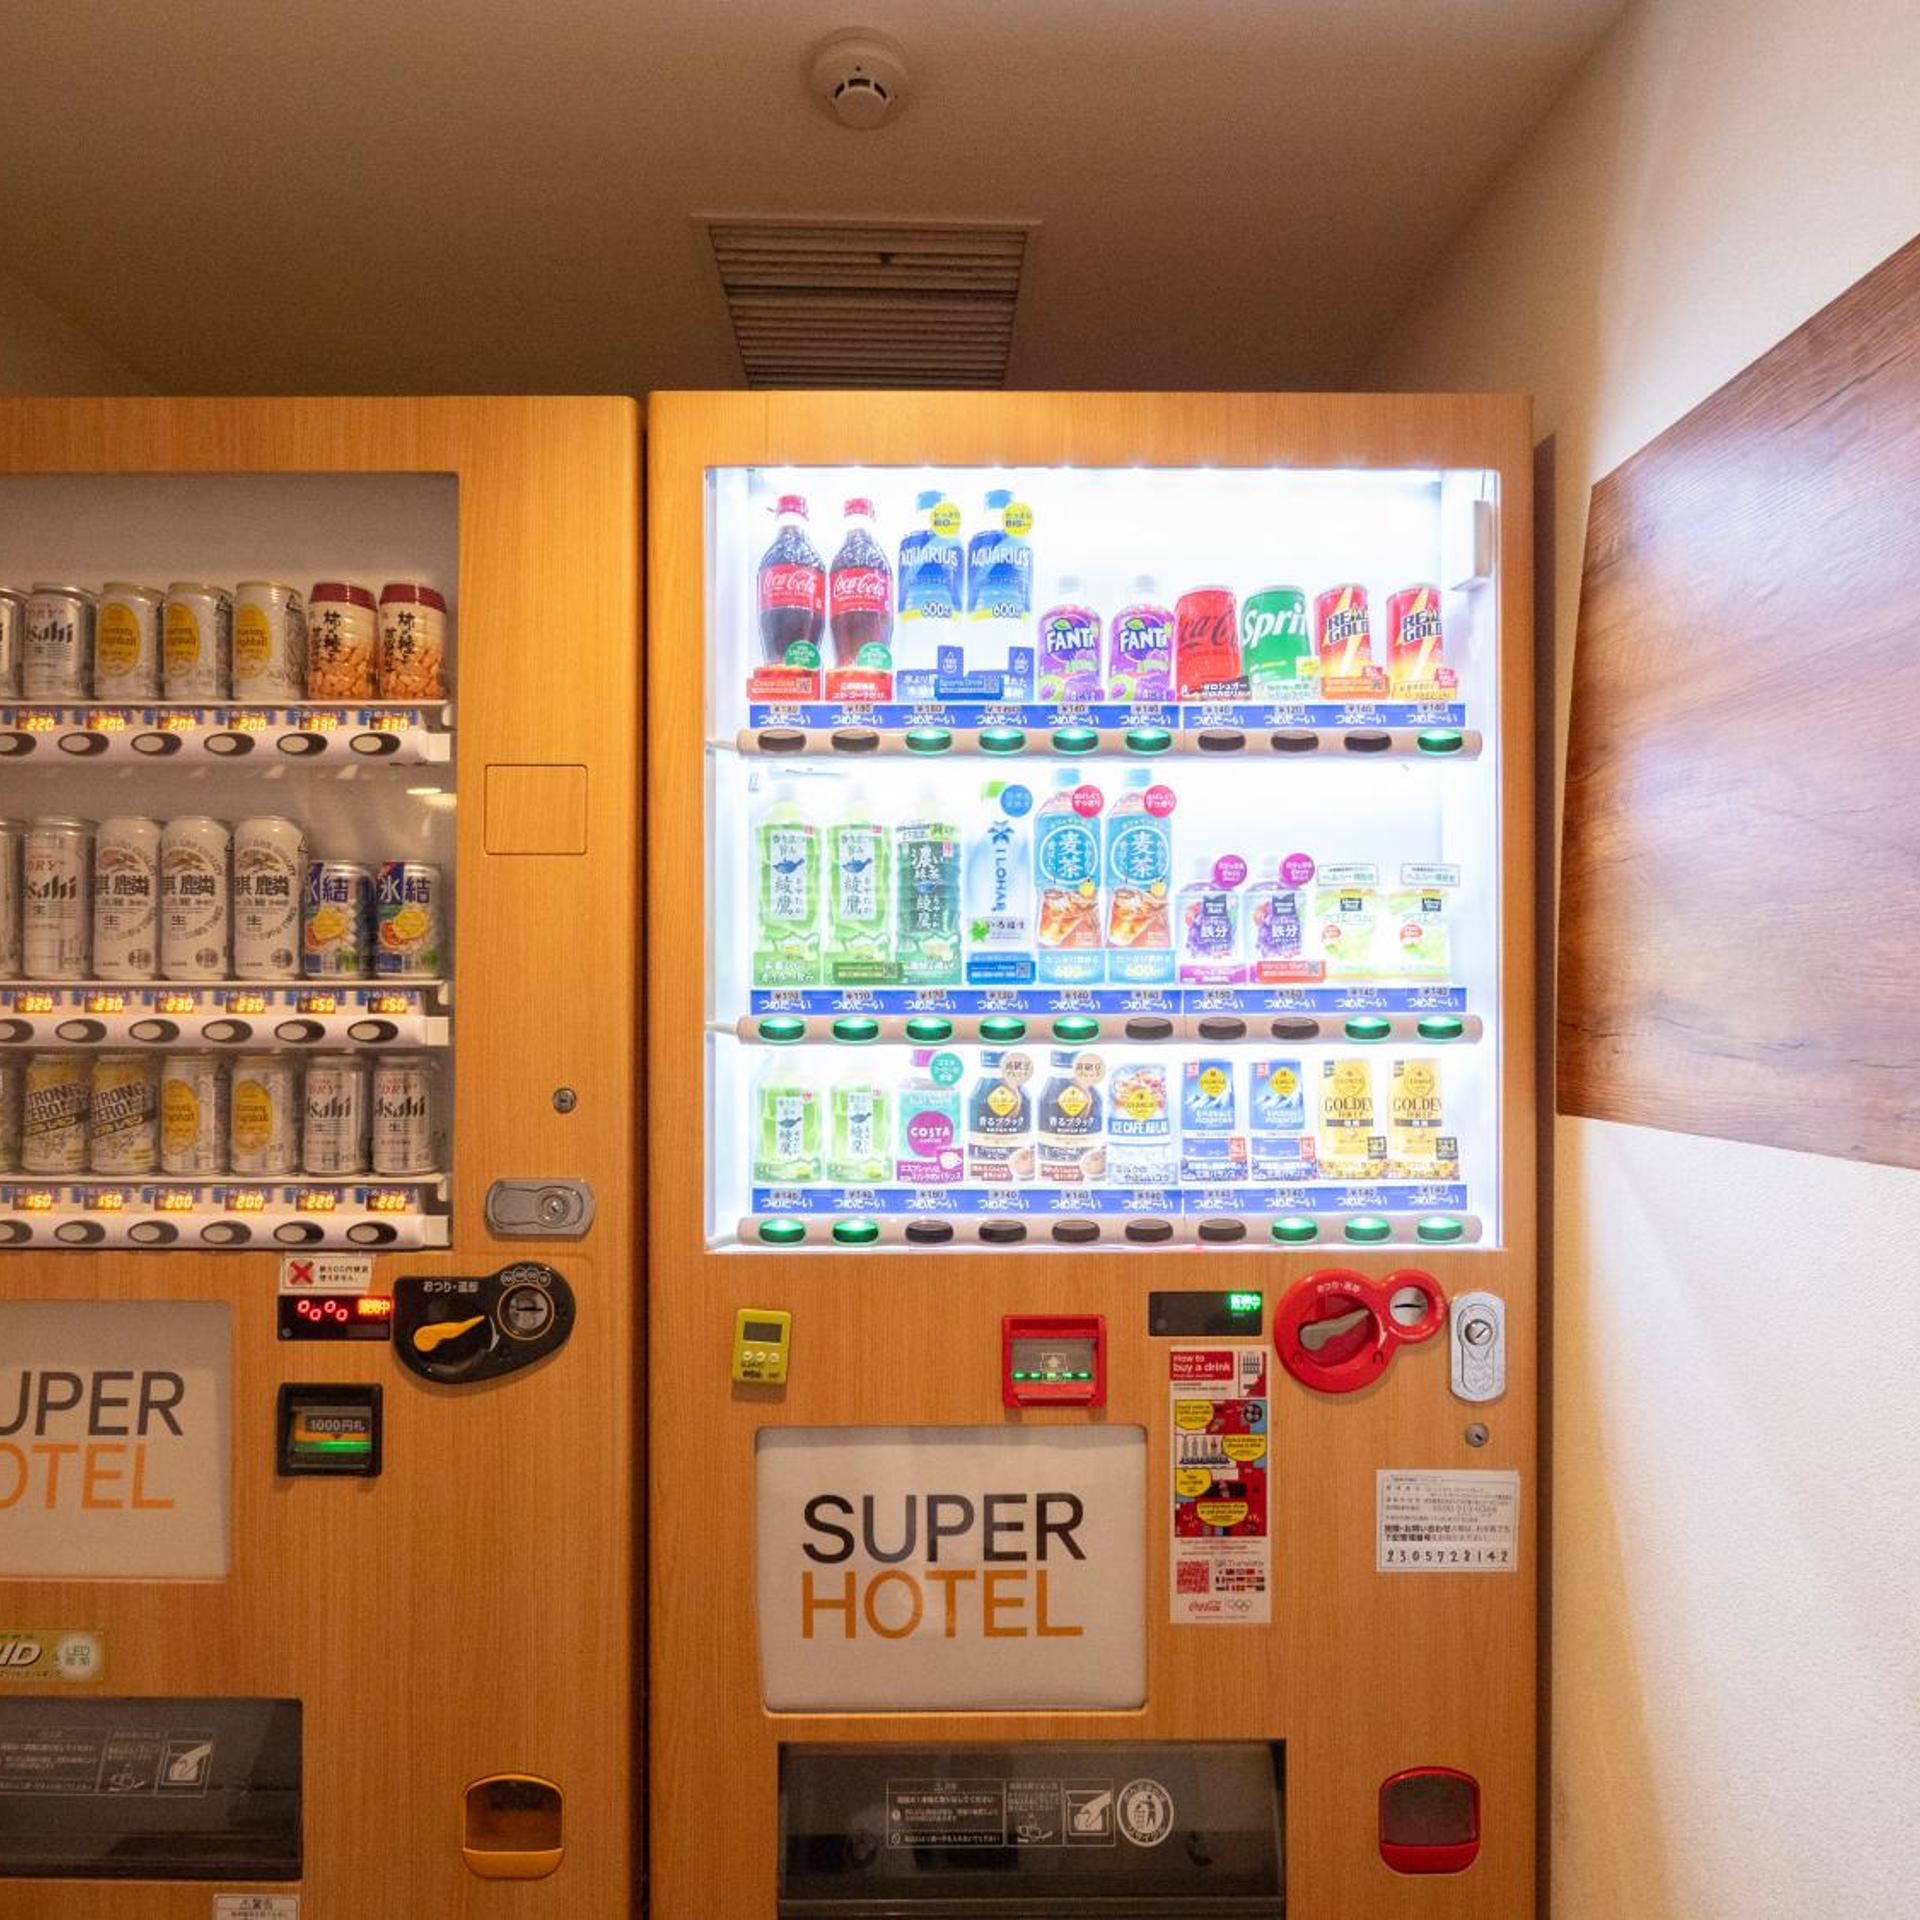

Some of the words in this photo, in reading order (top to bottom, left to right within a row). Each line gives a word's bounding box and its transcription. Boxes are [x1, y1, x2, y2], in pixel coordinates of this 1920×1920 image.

[1058, 832, 1082, 880] 麦茶
[1130, 832, 1153, 880] 麦茶
[910, 1126, 951, 1137] COSTA
[1173, 1363, 1194, 1374] buy
[1204, 1362, 1231, 1372] drink
[1195, 1354, 1205, 1362] to
[311, 1418, 365, 1432] 1000円札
[802, 1492, 1086, 1564] SUPER
[803, 1569, 1084, 1639] HOTEL
